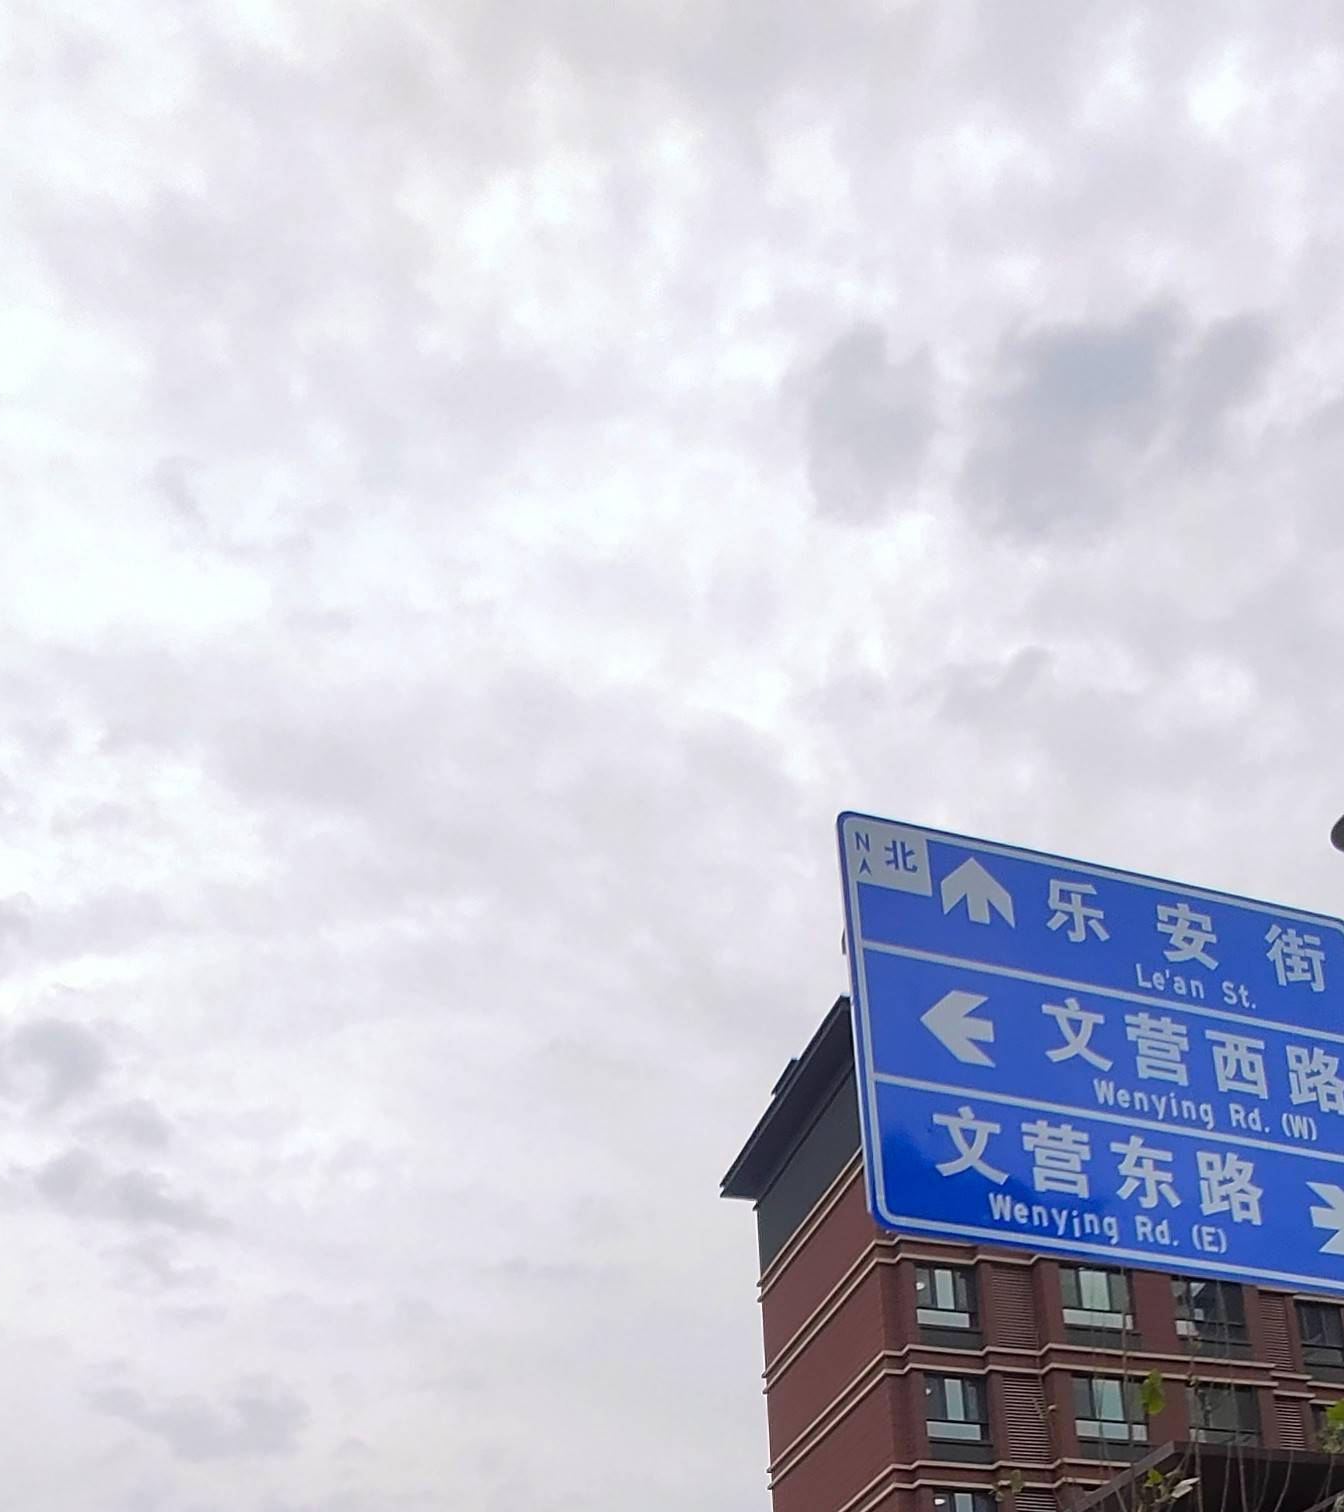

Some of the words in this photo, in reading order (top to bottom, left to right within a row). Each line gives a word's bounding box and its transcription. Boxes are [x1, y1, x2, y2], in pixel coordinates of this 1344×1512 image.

[854, 831, 870, 853] N
[884, 840, 918, 873] 北
[1046, 878, 1326, 993] 乐安街
[1135, 963, 1205, 999] Le'an
[1221, 981, 1257, 1009] St.
[1093, 1078, 1216, 1130] Wenying
[1229, 1103, 1270, 1134] Rd.
[1281, 1112, 1318, 1141] (W)
[932, 1105, 1264, 1226] 文营东路
[989, 1192, 1119, 1245] Wenying
[1135, 1214, 1180, 1247] Rd.
[1191, 1224, 1228, 1254] (E)
